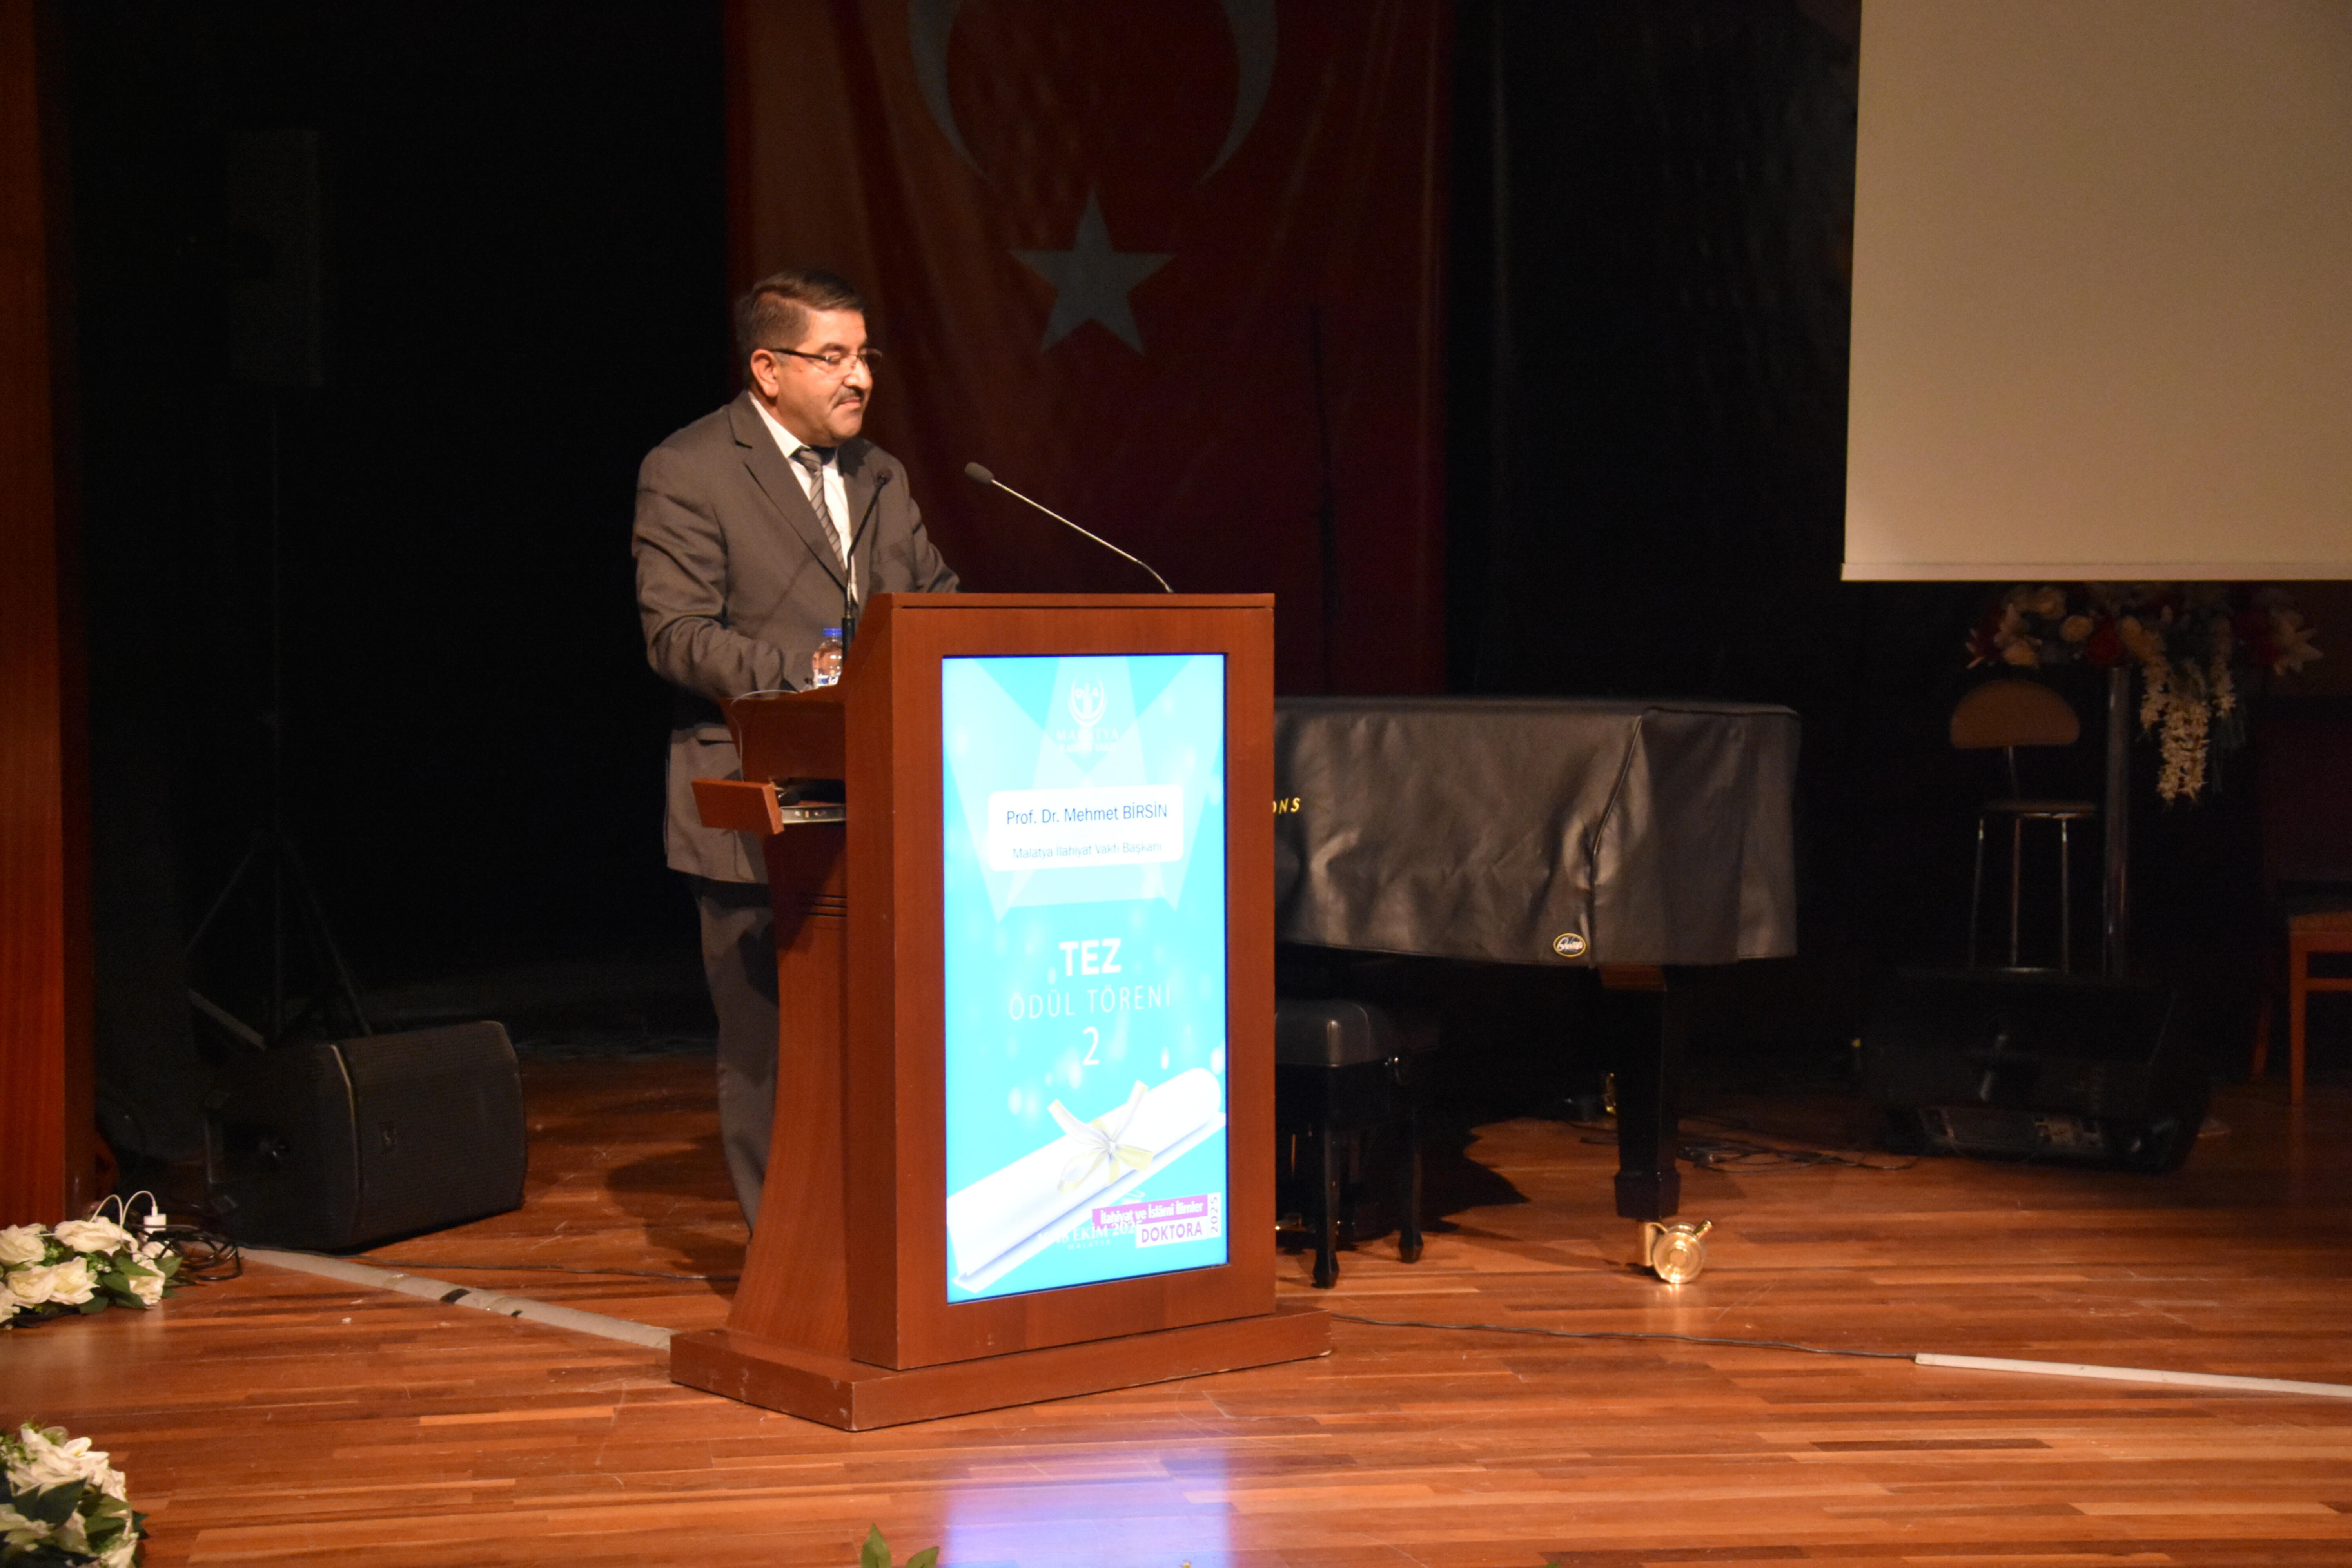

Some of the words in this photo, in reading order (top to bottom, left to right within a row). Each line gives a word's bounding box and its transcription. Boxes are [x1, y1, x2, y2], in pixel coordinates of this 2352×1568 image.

[1007, 809, 1037, 824] Prof.
[1042, 809, 1060, 823] Dr.
[1064, 807, 1118, 822] Mehmet
[1123, 802, 1168, 820] BİRSİN
[1013, 847, 1053, 860] Malatya
[1123, 841, 1162, 855] Başkanı
[1059, 938, 1122, 976] TEZ
[1009, 988, 1076, 1020] ÖDÜL
[1082, 1026, 1100, 1066] 2
[1134, 1209, 1147, 1220] ve
[1142, 1221, 1203, 1243] DOKTORA
